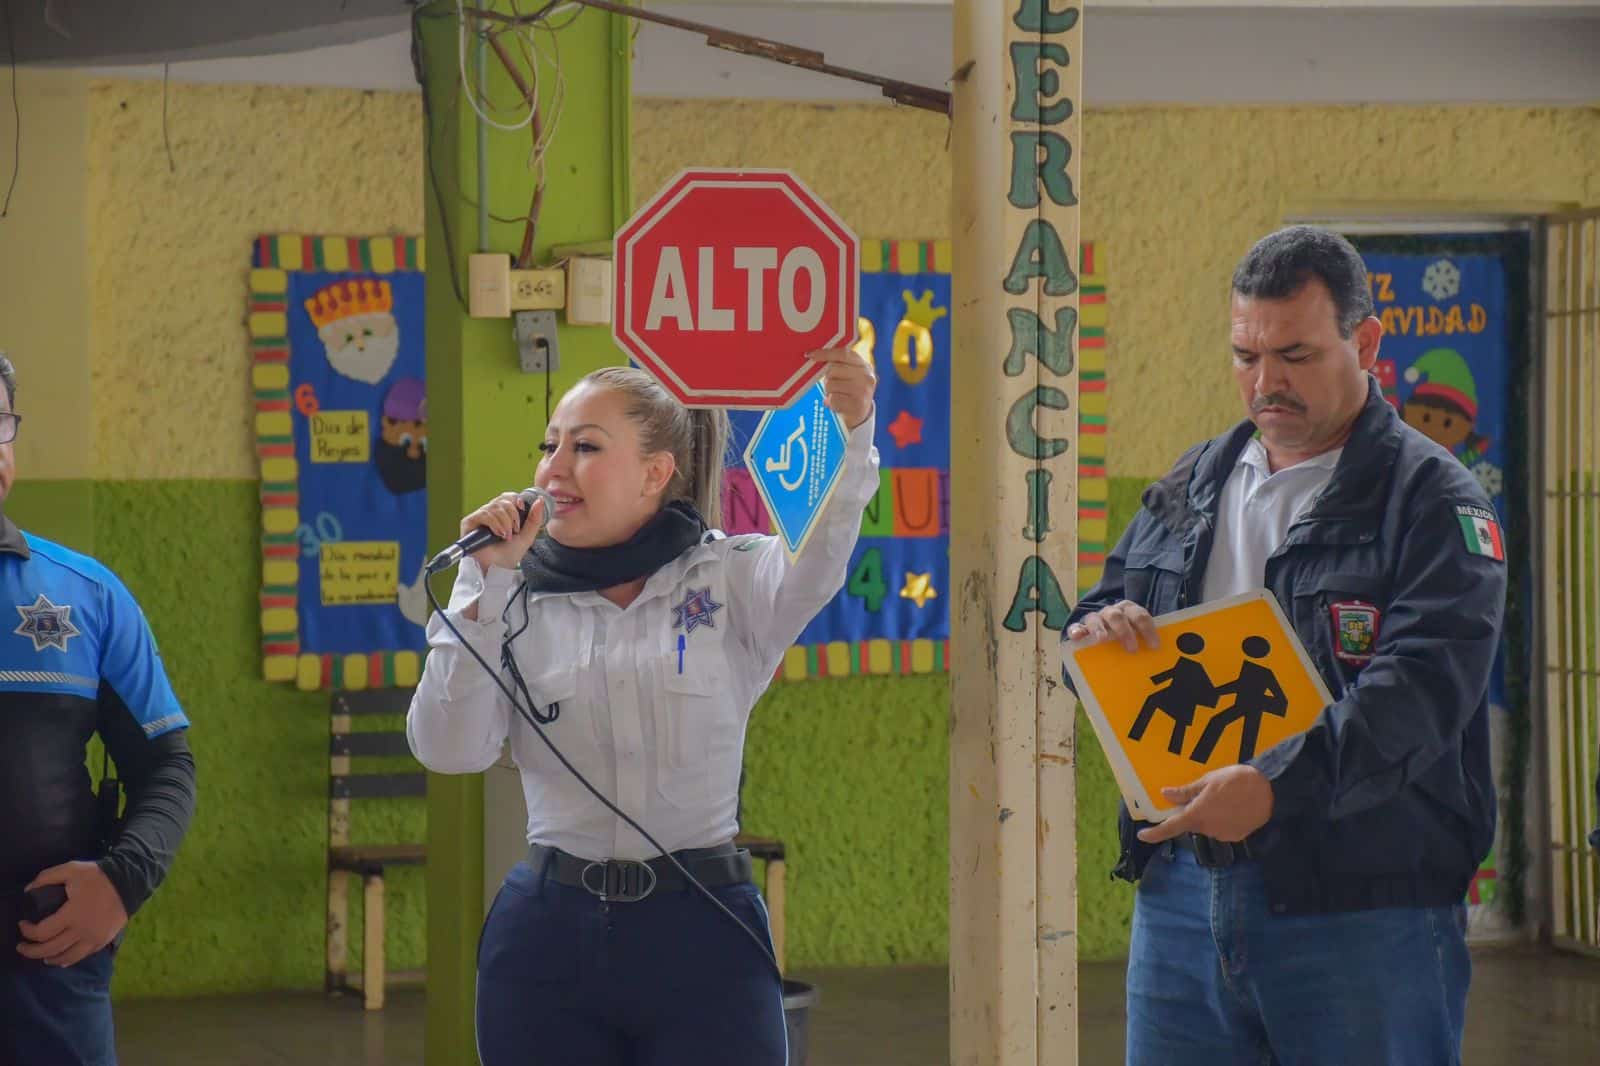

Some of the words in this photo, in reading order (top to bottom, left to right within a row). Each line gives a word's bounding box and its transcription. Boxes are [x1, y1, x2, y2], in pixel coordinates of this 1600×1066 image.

[645, 246, 826, 332] ALTO
[1380, 303, 1487, 336] AVIDAD
[295, 383, 320, 417] 6
[345, 413, 364, 435] de
[317, 438, 360, 461] Reyes
[295, 511, 343, 558] 30
